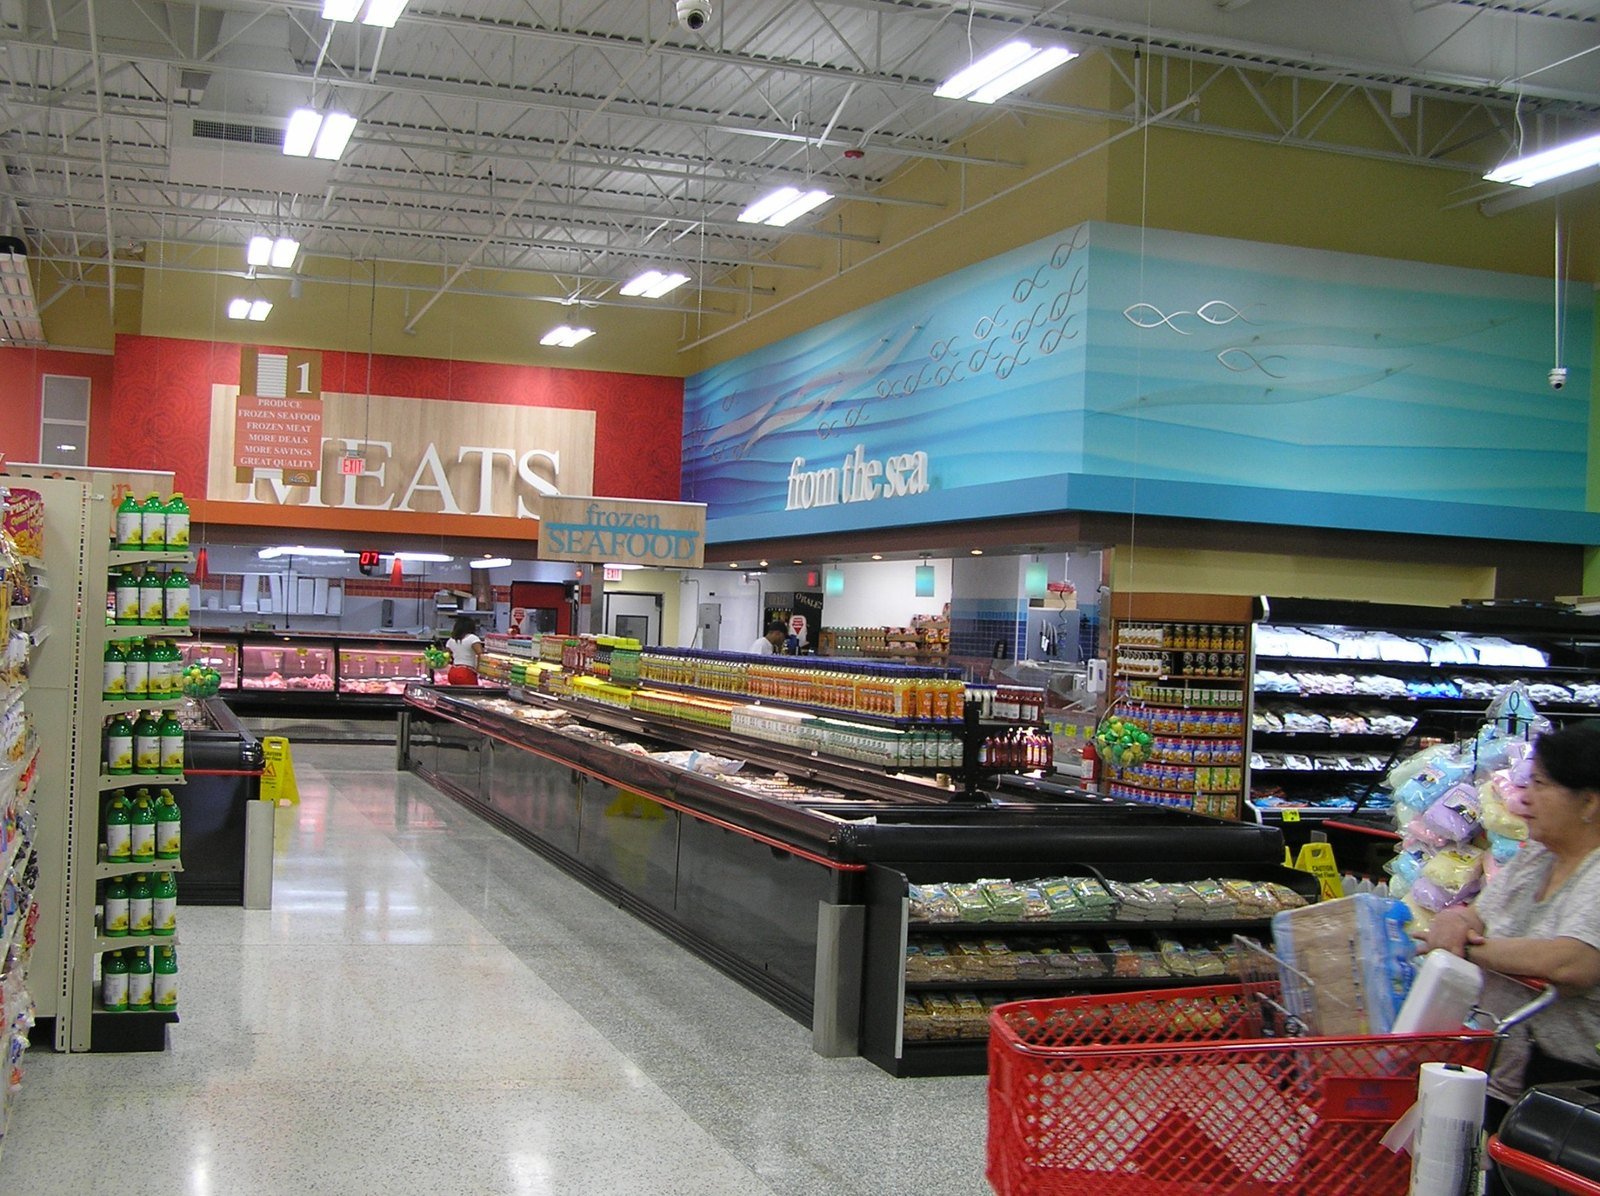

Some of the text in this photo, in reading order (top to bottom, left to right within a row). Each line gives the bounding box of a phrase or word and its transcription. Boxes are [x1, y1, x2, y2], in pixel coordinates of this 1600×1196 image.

[296, 362, 312, 393] 1
[258, 398, 302, 409] PRODUCE
[238, 409, 321, 421] FROZEN SEAFOOD
[247, 421, 312, 433] FROZEN MEAT
[249, 433, 309, 445] MORE DEALS
[245, 445, 312, 456] MORE SAVINGS
[240, 457, 316, 469] GREAT QUALITY
[341, 458, 363, 475] EXIT
[785, 443, 930, 511] from the sea
[586, 503, 661, 530] frozen
[547, 527, 696, 560] SEAFOOD
[360, 552, 379, 565] 07
